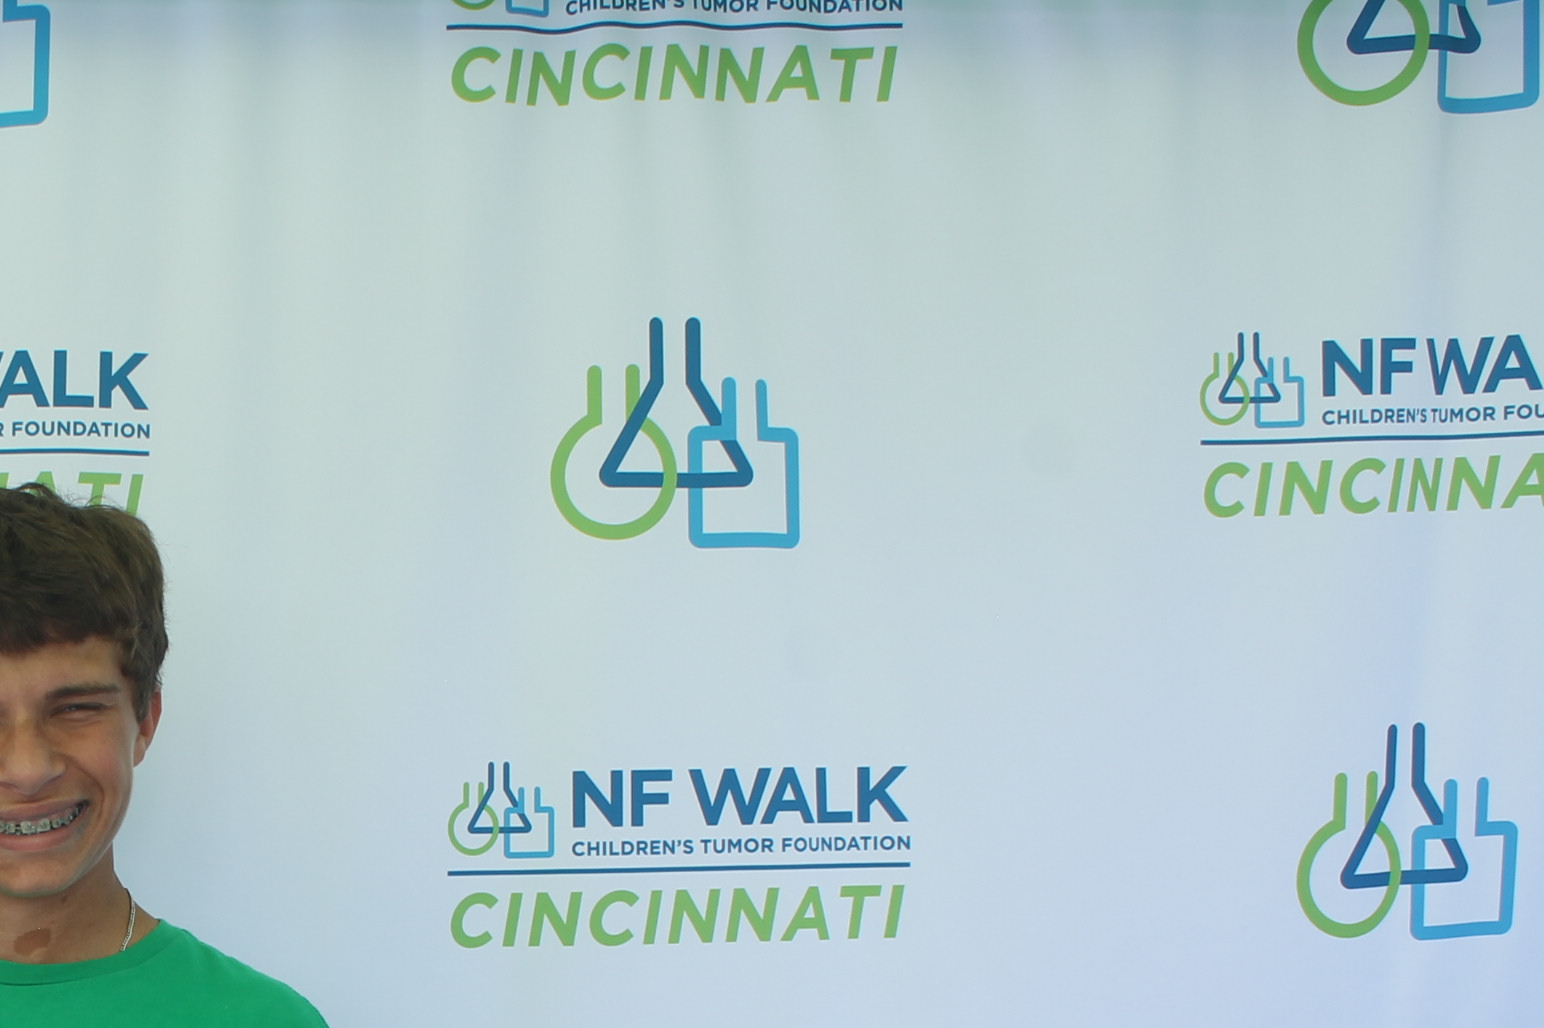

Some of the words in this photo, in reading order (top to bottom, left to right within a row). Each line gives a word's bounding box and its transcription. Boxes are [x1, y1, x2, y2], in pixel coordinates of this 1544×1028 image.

[566, 0, 685, 16] CHILDRENS
[767, 0, 903, 14] FOUNDATION
[451, 43, 898, 106] CINCINNATI
[1322, 338, 1416, 397] NF
[1426, 334, 1544, 395] WA
[11, 420, 150, 440] FOUNDATION
[1322, 408, 1427, 425] CHILDREN'S
[1431, 406, 1496, 423] TUMOR
[1204, 453, 1544, 518] CINCINNA
[572, 768, 672, 828] NF
[688, 766, 909, 826] WALK
[571, 840, 694, 857] CHILDREN'S
[700, 837, 774, 855] TUMOR
[782, 835, 911, 854] FOUNDATION
[450, 885, 905, 949] CINCINNATI
